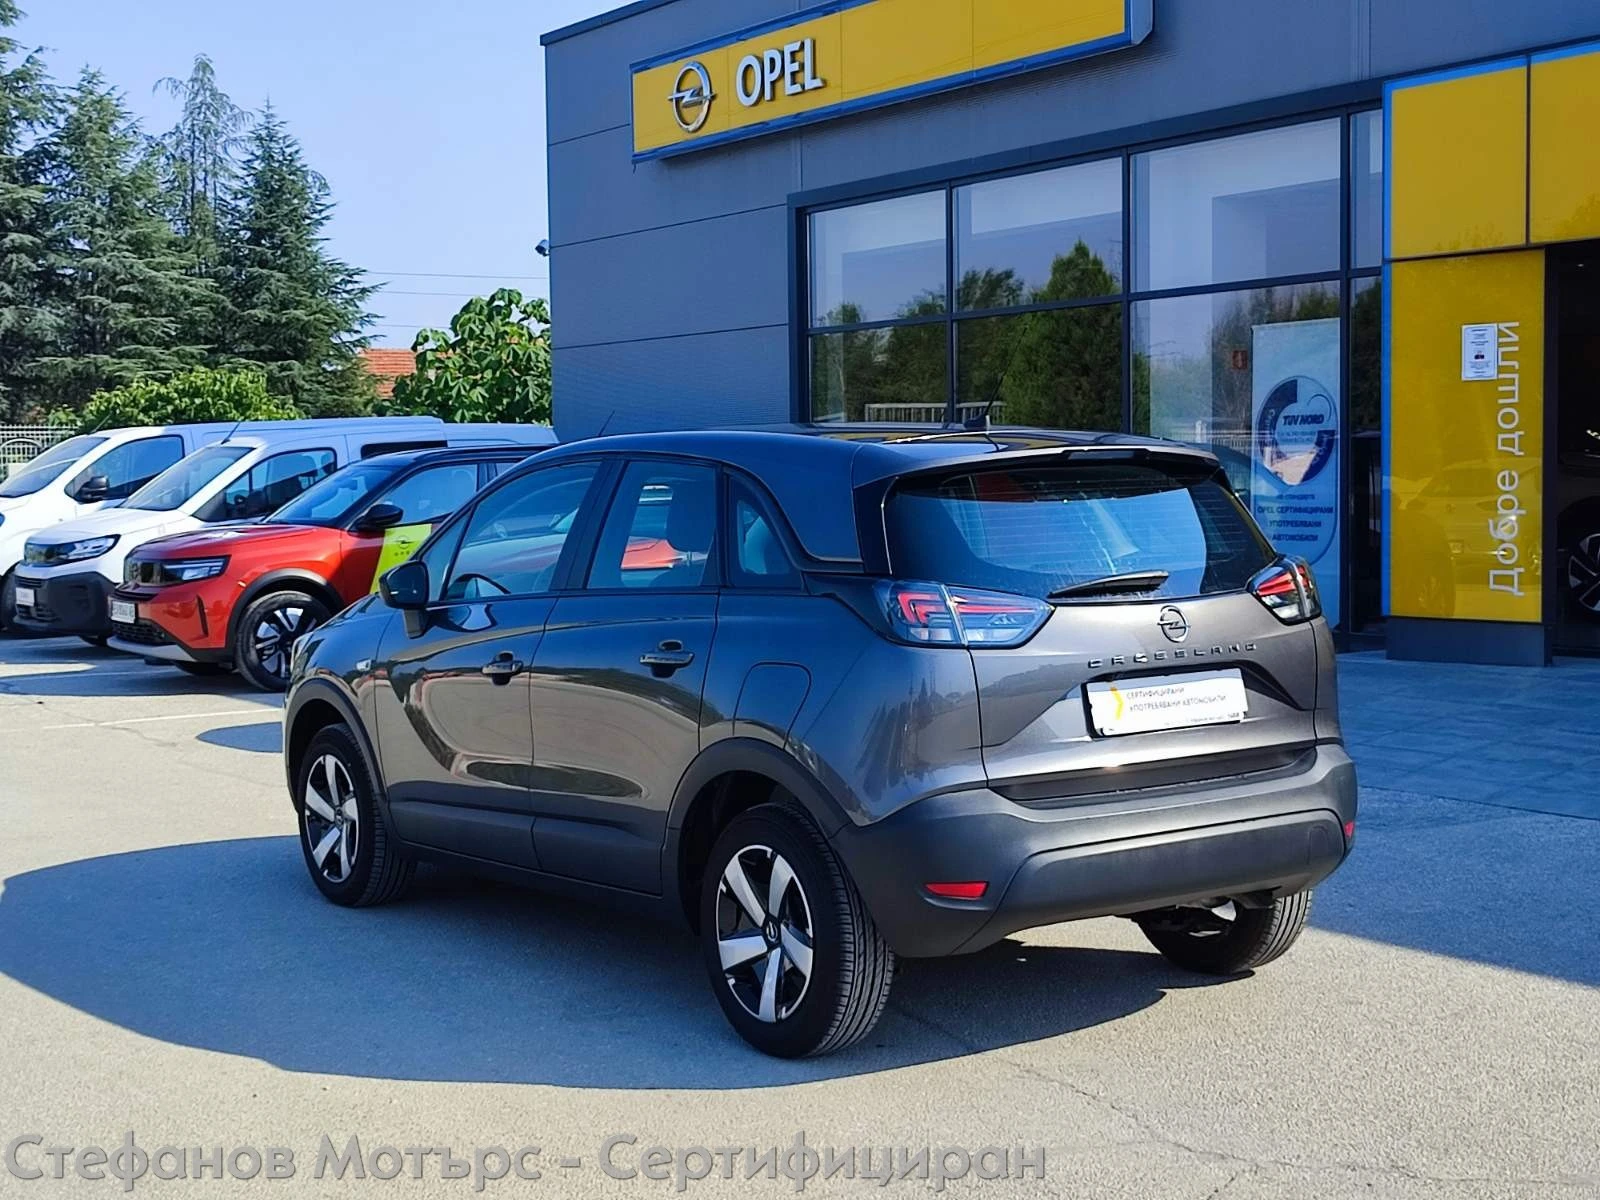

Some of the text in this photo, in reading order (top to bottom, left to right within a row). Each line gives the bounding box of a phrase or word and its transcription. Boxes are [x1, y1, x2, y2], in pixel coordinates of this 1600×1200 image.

[735, 37, 825, 107] OPEL
[1300, 414, 1325, 425] NORD
[1488, 321, 1527, 596] Добре дошли
[1088, 643, 1257, 669] CROSSLAND
